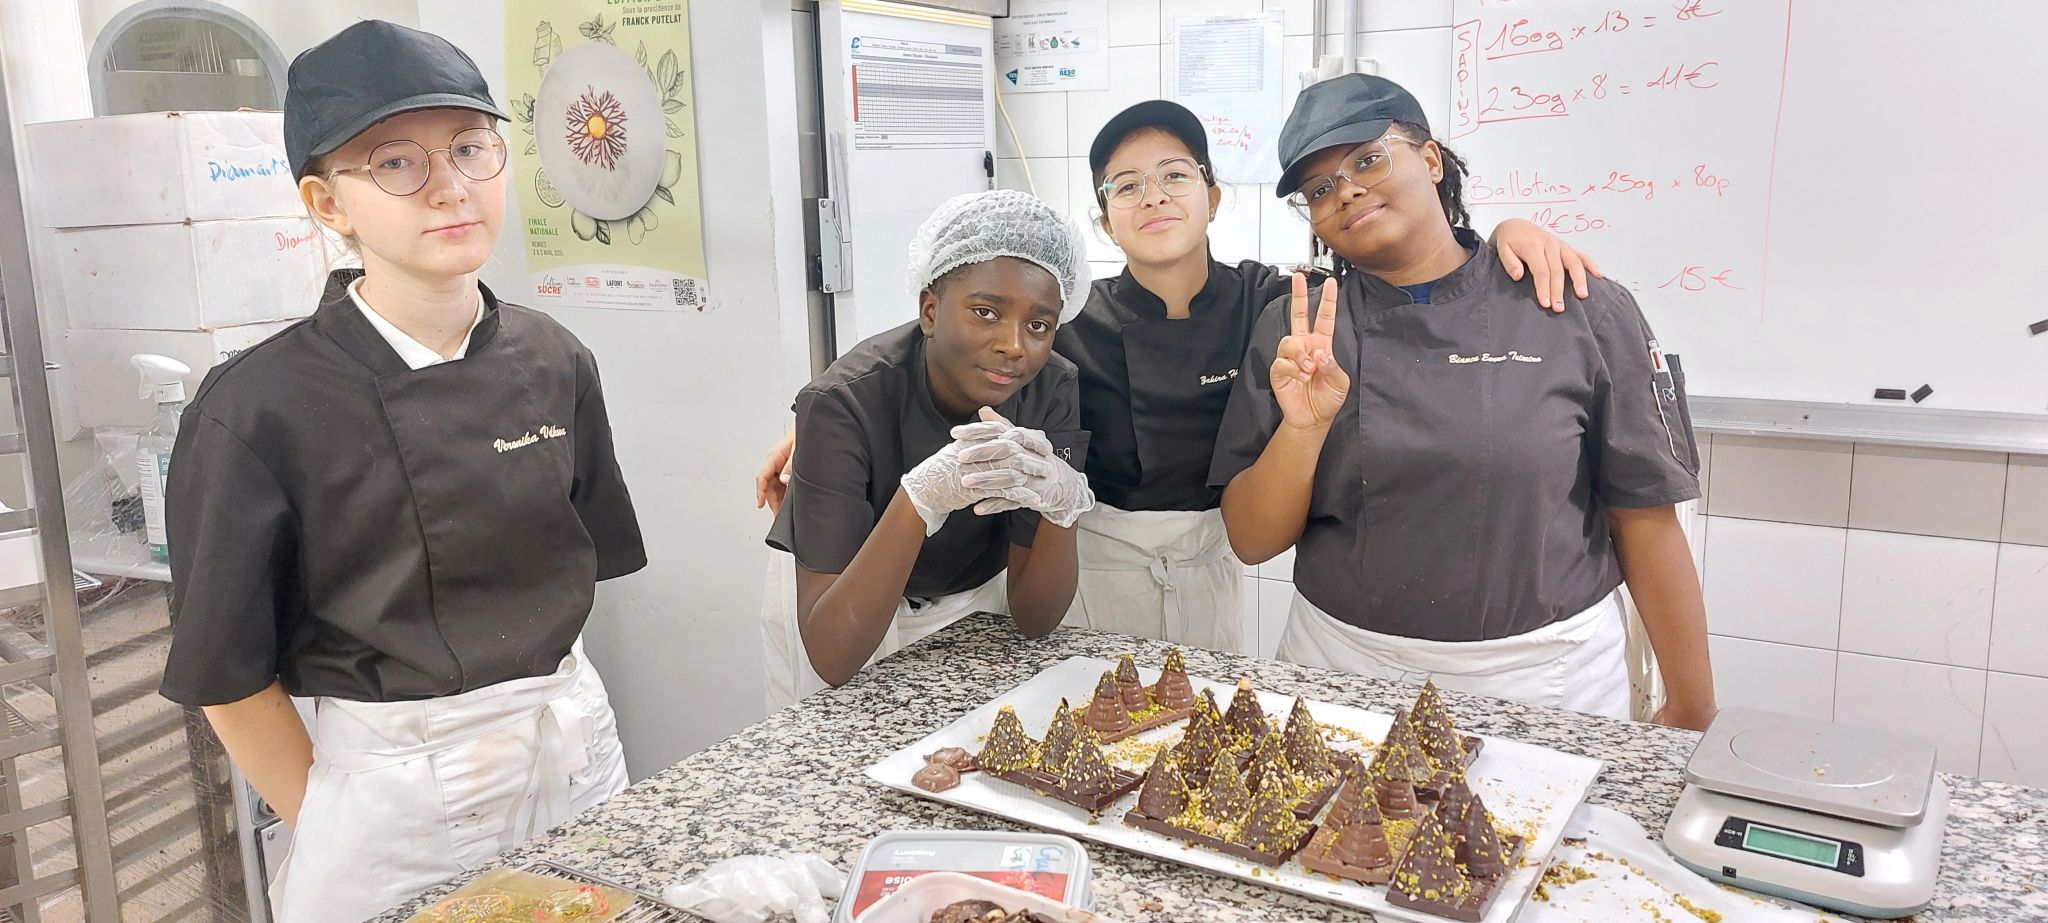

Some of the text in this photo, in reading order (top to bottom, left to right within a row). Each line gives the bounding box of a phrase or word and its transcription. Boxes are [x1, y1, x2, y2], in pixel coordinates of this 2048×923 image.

[622, 6, 636, 14] Sous
[622, 14, 682, 27] FRANCK PUTELAT
[1484, 19, 1564, 51] 160g
[1593, 10, 1630, 33] 13
[1592, 73, 1608, 99] 8
[208, 158, 291, 182] Diamants
[1468, 170, 1572, 200] Ballotins
[1601, 171, 1655, 201] 250g
[528, 218, 548, 226] FINALE
[529, 228, 559, 236] NATIONALE
[537, 285, 562, 295] SUCRE
[606, 280, 623, 288] LAFONT
[493, 431, 540, 454] Veronika
